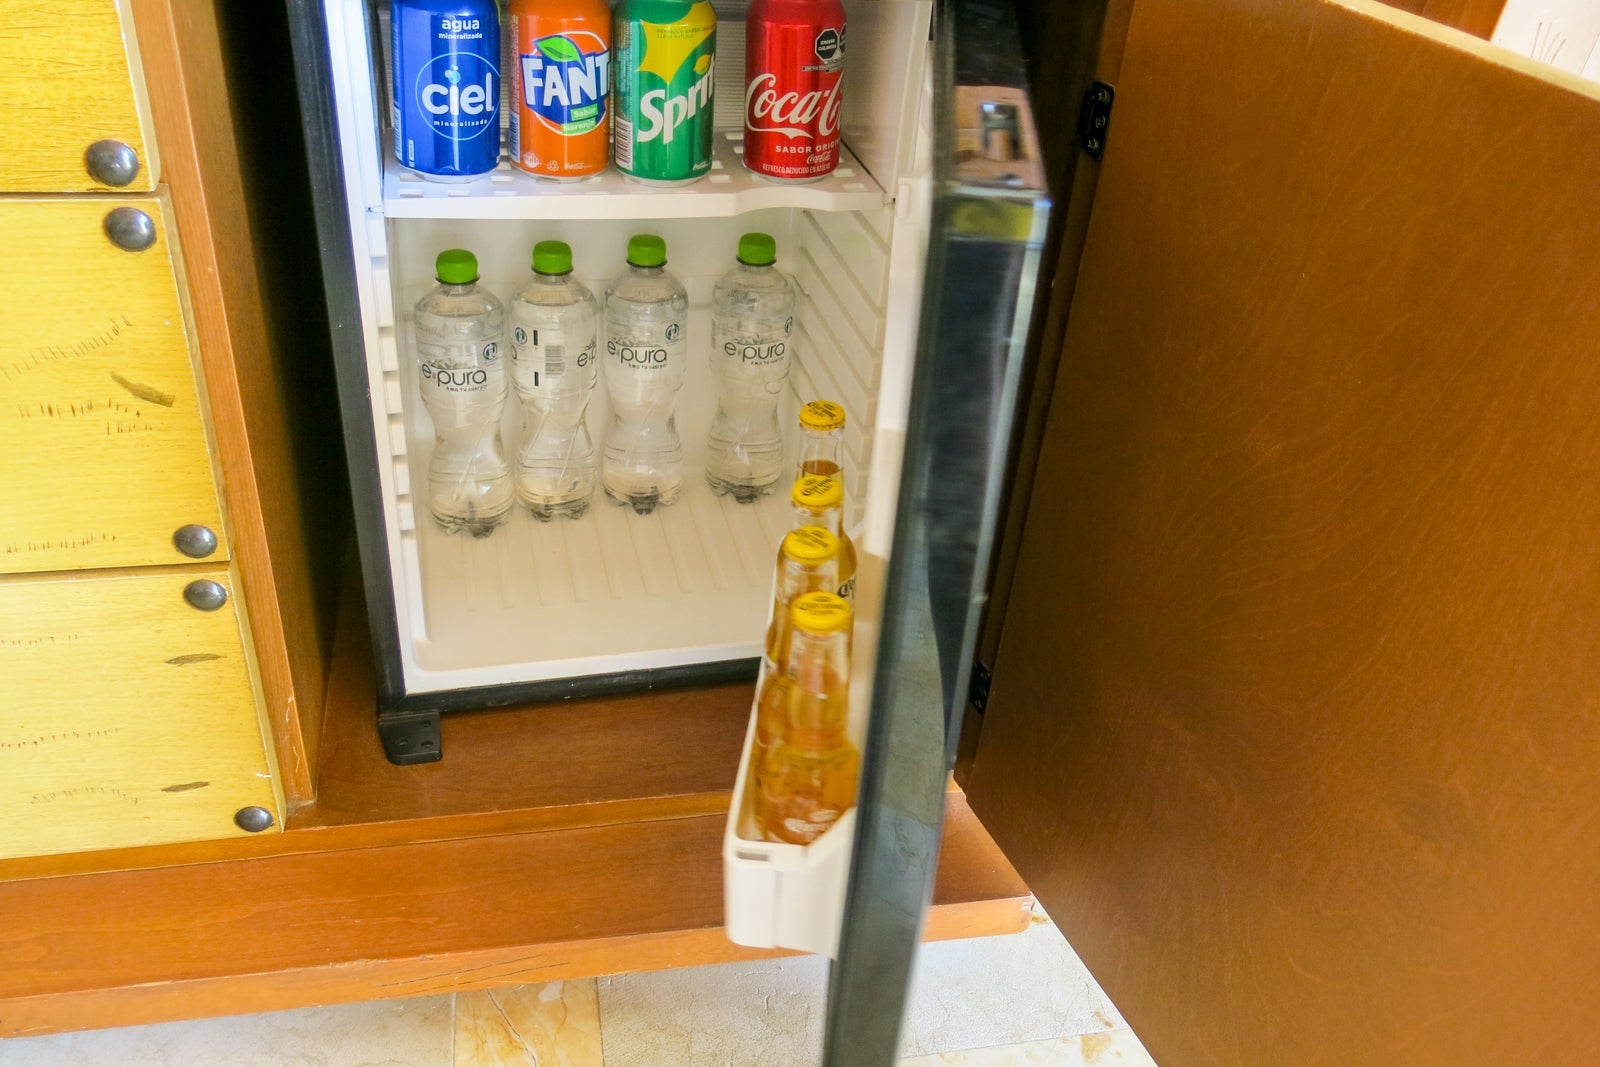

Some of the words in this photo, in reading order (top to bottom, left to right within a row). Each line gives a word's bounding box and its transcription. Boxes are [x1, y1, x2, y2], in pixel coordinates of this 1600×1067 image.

[441, 19, 480, 33] agua
[521, 51, 611, 107] FANT
[421, 70, 494, 116] ciel
[573, 106, 597, 118] Sabor
[433, 119, 488, 127] mineralizada
[563, 119, 597, 132] Naranja
[775, 145, 812, 154] SABOR
[762, 163, 785, 174] REFRESCO
